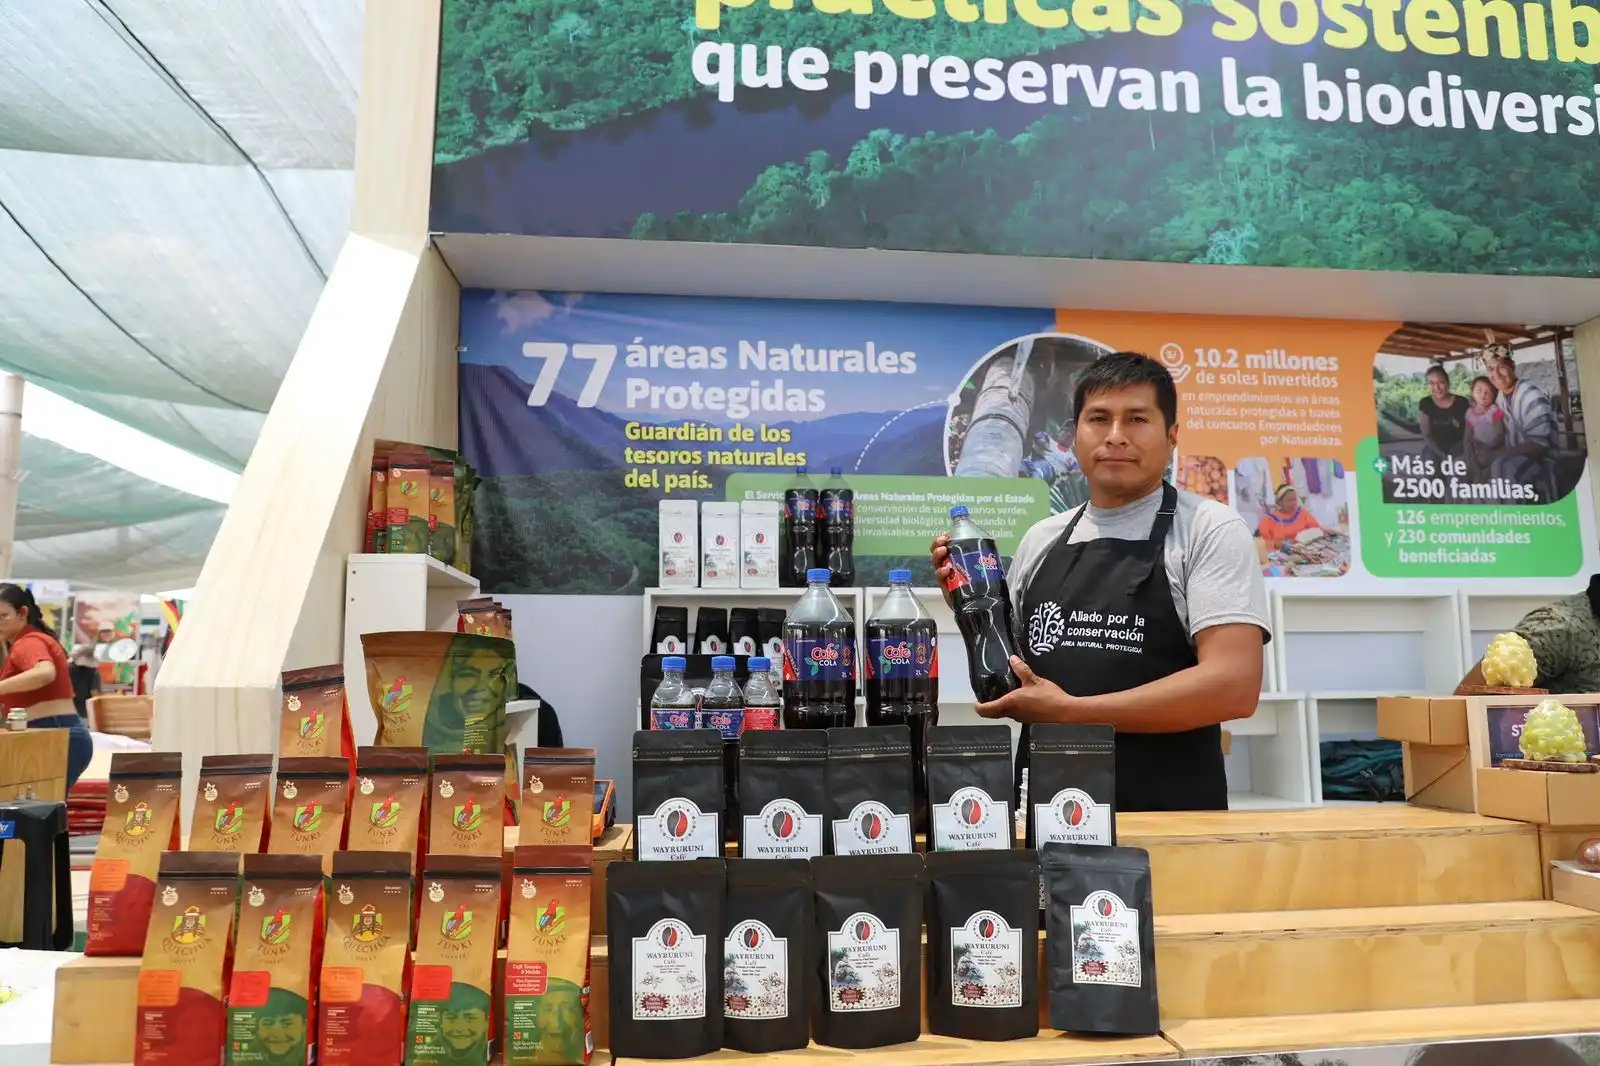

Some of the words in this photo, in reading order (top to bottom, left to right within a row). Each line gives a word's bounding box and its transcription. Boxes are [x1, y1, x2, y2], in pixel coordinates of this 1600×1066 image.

[692, 40, 829, 102] que
[855, 48, 1200, 113] preservan
[1222, 57, 1282, 118] la
[625, 337, 728, 371] áreas
[738, 340, 917, 374] Naturales
[1194, 348, 1239, 368] 10.2
[1245, 349, 1339, 372] millones
[522, 342, 618, 408] 77
[1195, 370, 1215, 385] de
[1220, 370, 1258, 386] soles
[1263, 372, 1338, 388] invertidos
[626, 377, 826, 419] Protegidas
[1182, 393, 1195, 401] en
[1198, 391, 1294, 405] emprendimientos
[1296, 395, 1309, 405] en
[1311, 394, 1341, 406] áreas
[1187, 406, 1237, 417] naturales
[1240, 408, 1297, 420] protegidas
[1299, 410, 1306, 418] a
[1309, 408, 1341, 419] través
[624, 421, 723, 442] Guardián
[728, 422, 755, 442] de
[761, 423, 791, 443] los
[1187, 419, 1204, 430] del
[1207, 421, 1256, 431] concurso
[1258, 421, 1342, 433] Emprendedores
[1260, 436, 1279, 446] por
[1281, 435, 1342, 446] Naturaleza.
[624, 446, 702, 465] tesoros
[708, 448, 807, 468] naturales
[1391, 454, 1436, 476] Más
[1441, 454, 1467, 476] de
[624, 469, 659, 489] del
[664, 470, 713, 493] país.
[1393, 478, 1445, 498] 2500
[1450, 477, 1539, 502] familias,
[745, 491, 755, 500] El
[880, 491, 925, 502] Naturales
[927, 492, 975, 505] Protegidas
[976, 494, 992, 505] por
[994, 493, 1003, 503] el
[1005, 494, 1035, 504] Estado
[857, 503, 917, 514] conservación
[919, 504, 930, 514] de
[902, 515, 944, 528] biológica
[1008, 517, 1017, 526] la
[1396, 509, 1426, 525] 126
[1431, 510, 1567, 527] emprendimientos,
[1385, 532, 1394, 547] y
[1398, 529, 1426, 544] 230
[1430, 530, 1531, 544] comunidades
[1398, 548, 1497, 564] beneficiadas
[1069, 610, 1103, 623] Aliado
[1107, 613, 1129, 626] por
[1134, 614, 1145, 627] la
[1067, 627, 1144, 642] conservación
[1076, 641, 1104, 649] NATURAL
[1105, 643, 1143, 654] PROTEGIDA
[819, 659, 838, 667] COLA
[891, 658, 911, 666] COLA
[367, 826, 398, 838] TUNKI
[450, 829, 483, 841] TUNKI
[540, 826, 572, 837] TUNKI
[947, 831, 998, 841] WAYRURUNI
[1049, 833, 1099, 841] WAYRURUNI
[652, 844, 704, 854] WAYRURUNI
[757, 845, 809, 853] WAYRURUNI
[848, 845, 899, 856] WAYRURUNI
[437, 938, 472, 951] TUNKI
[532, 934, 566, 947] TUNKI
[964, 942, 1010, 950] WAYRURUNI
[646, 951, 693, 959] WAYRURUNI
[841, 944, 887, 953] WAYRURUNI
